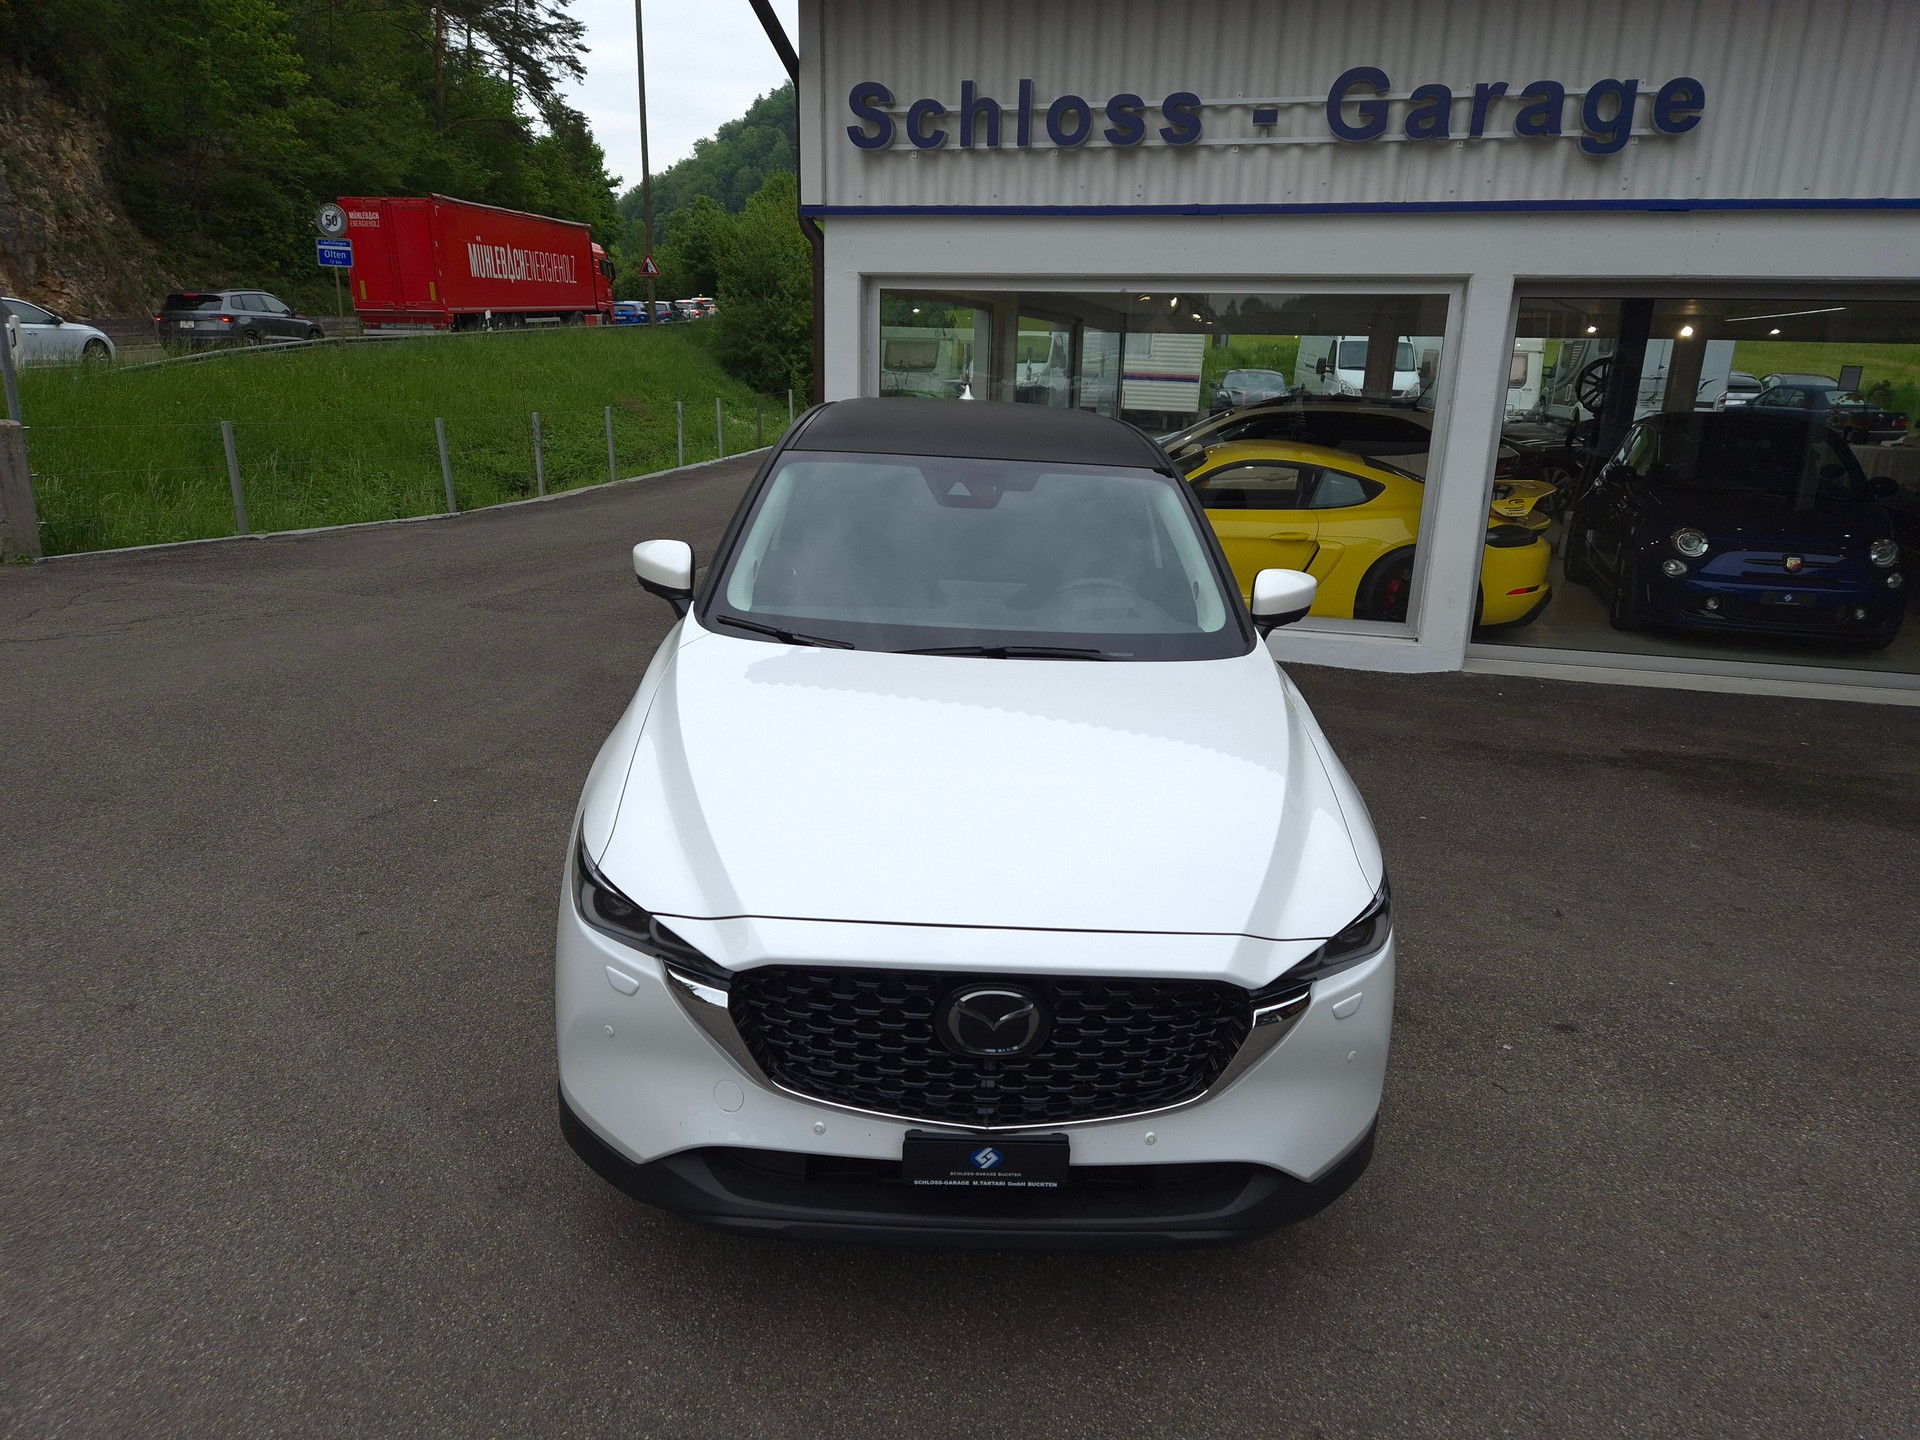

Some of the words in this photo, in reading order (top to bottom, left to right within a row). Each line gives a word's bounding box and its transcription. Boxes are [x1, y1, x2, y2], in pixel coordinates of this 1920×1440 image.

[846, 78, 1202, 151] Schloss
[1252, 108, 1278, 127] -
[1325, 66, 1707, 156] Garage
[325, 214, 338, 227] 50
[324, 249, 346, 259] Olten
